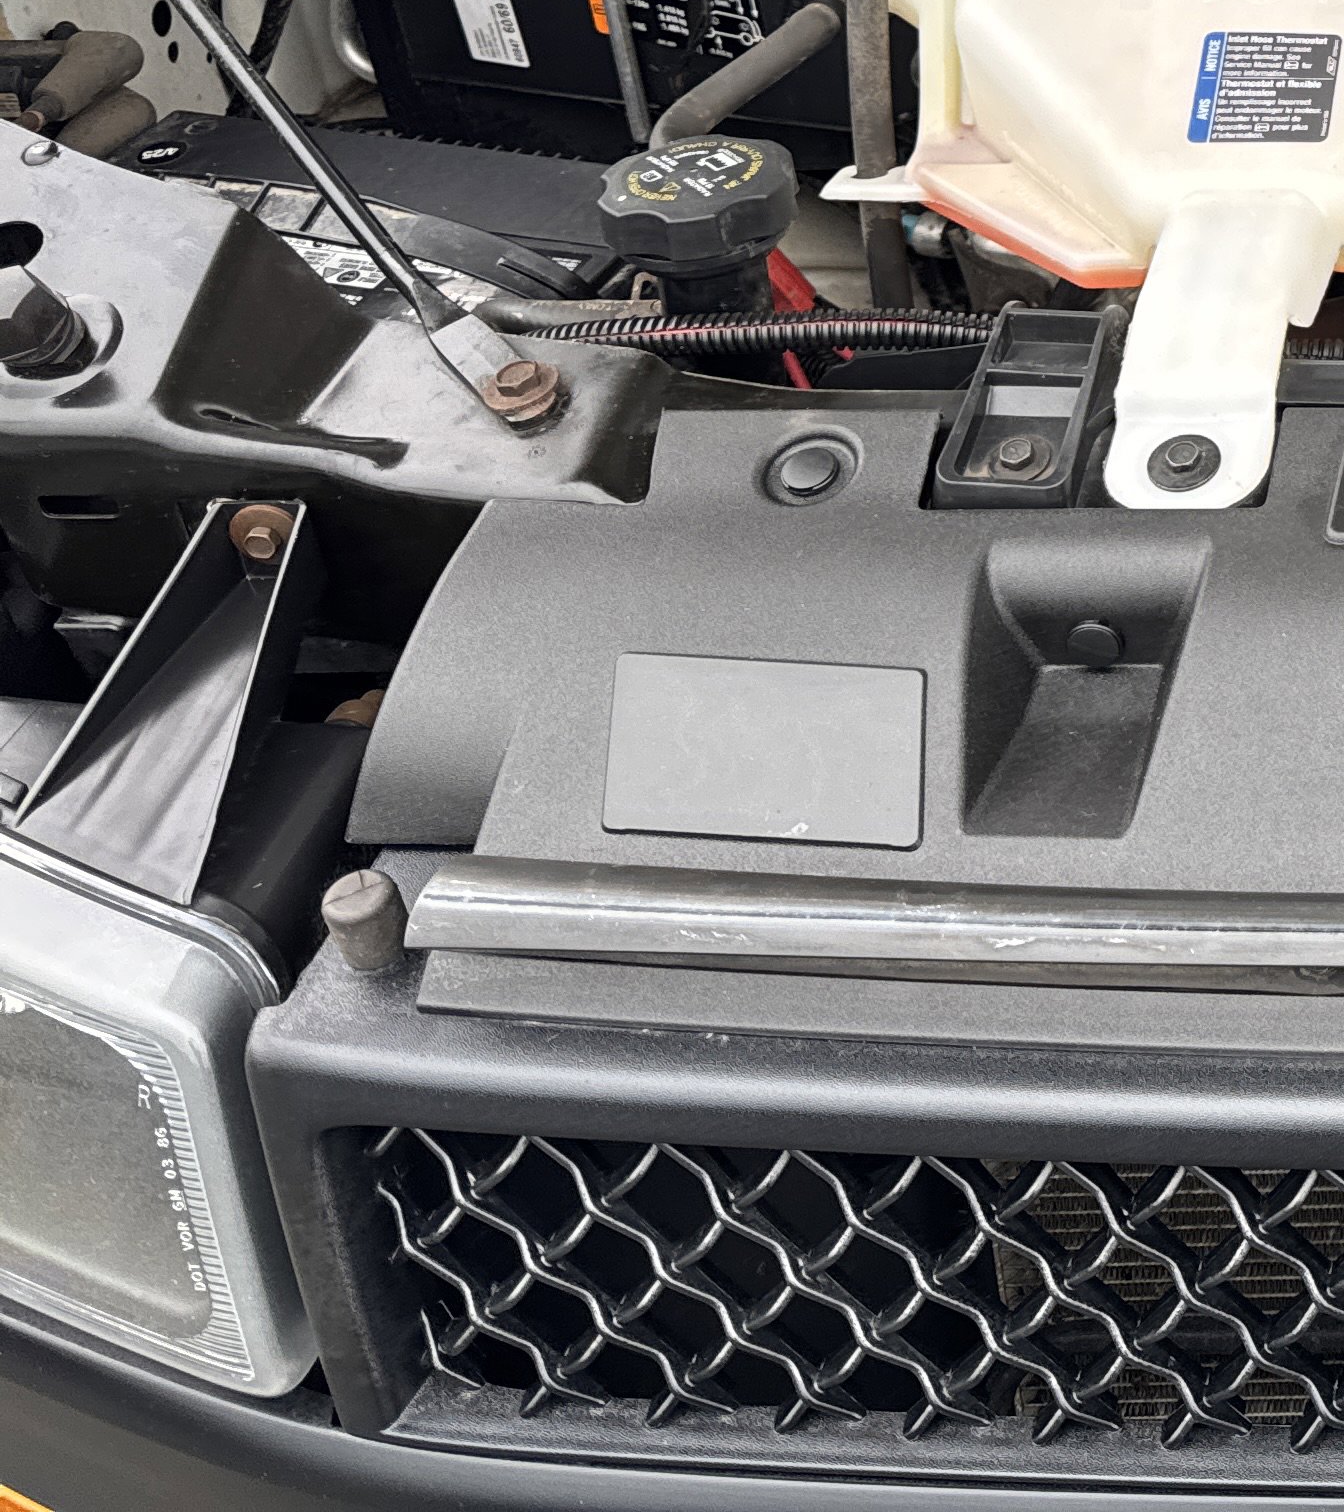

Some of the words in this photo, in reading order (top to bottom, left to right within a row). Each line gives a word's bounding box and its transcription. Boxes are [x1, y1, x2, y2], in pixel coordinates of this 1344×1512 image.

[1276, 36, 1328, 44] Thermostat
[1204, 40, 1221, 72] NOTICE
[1288, 80, 1322, 88] flexible
[1196, 98, 1211, 120] AVIS
[138, 1085, 150, 1109] R
[162, 1158, 177, 1180] 03
[168, 1190, 187, 1212] GM
[177, 1221, 194, 1252] VOR
[188, 1262, 206, 1292] DOT
